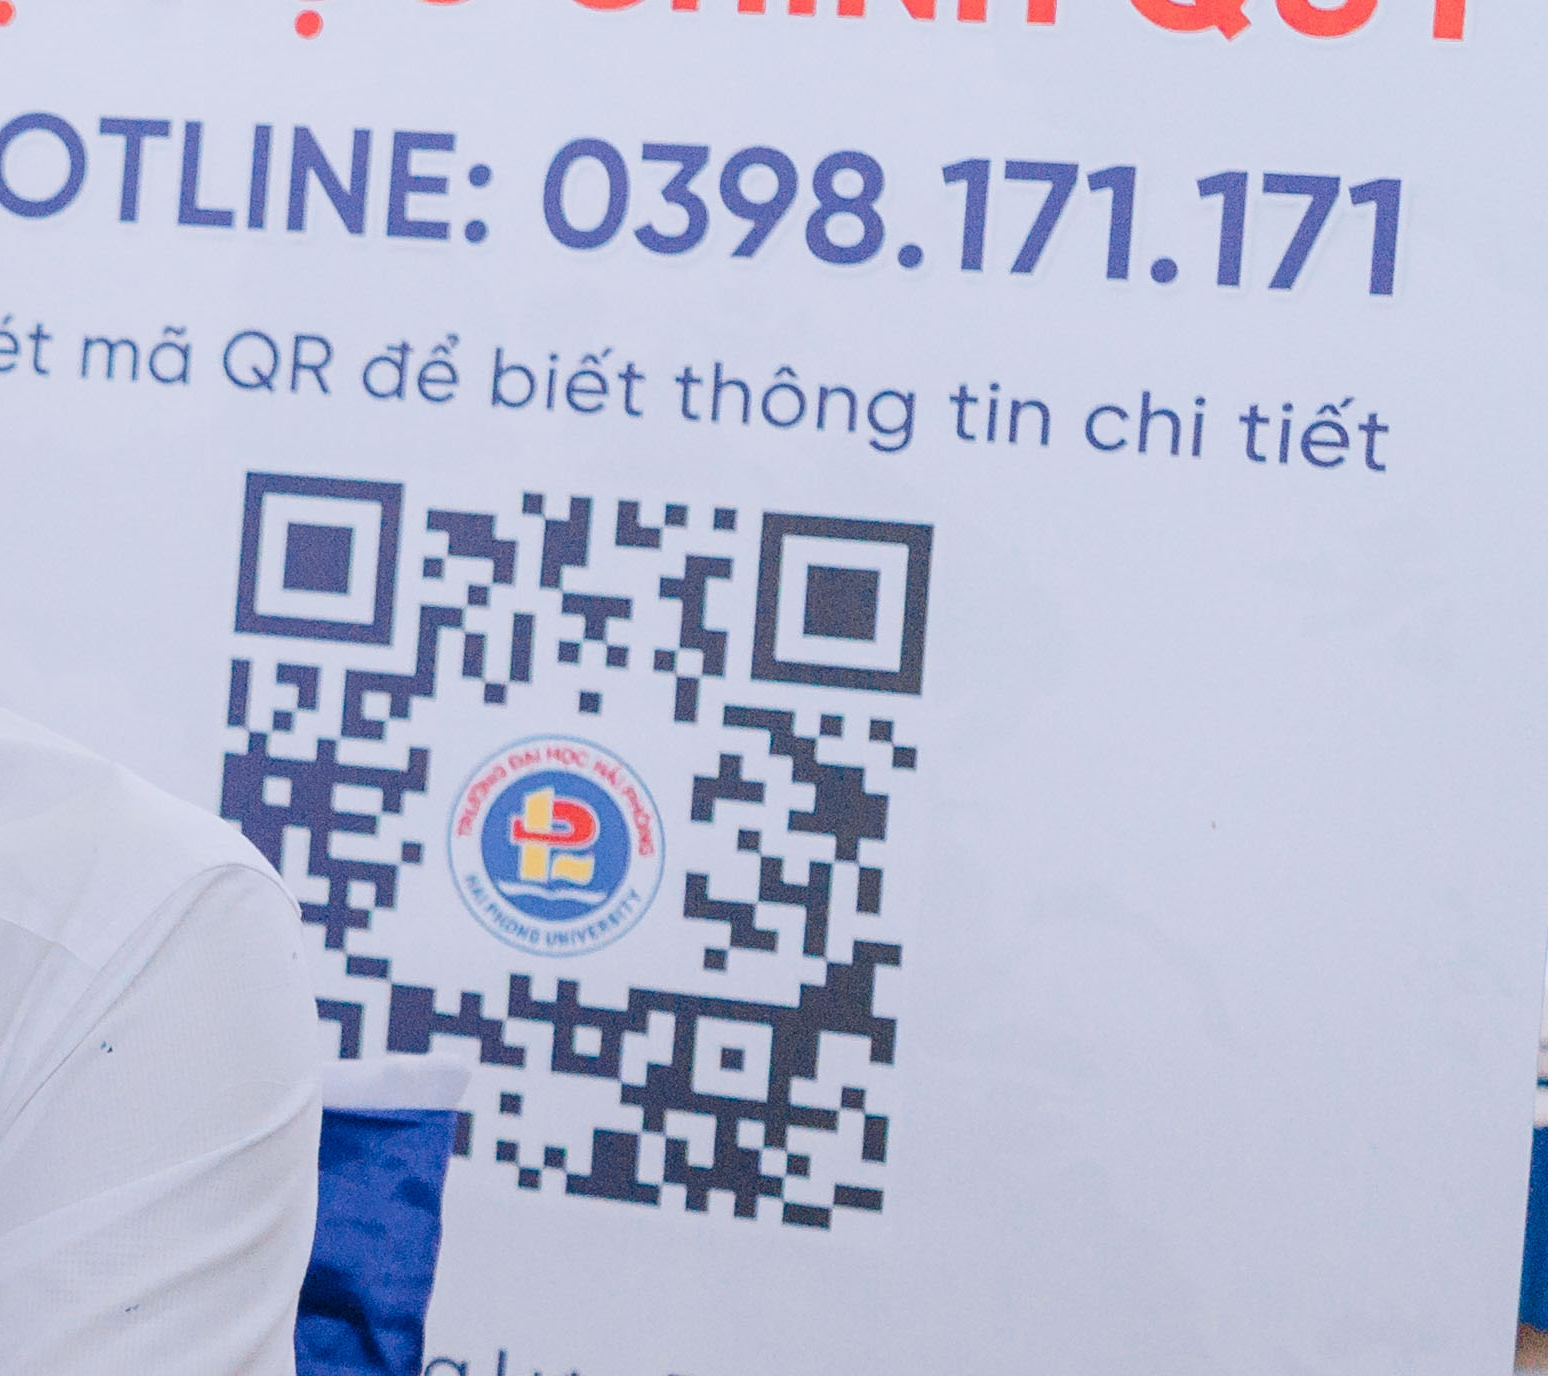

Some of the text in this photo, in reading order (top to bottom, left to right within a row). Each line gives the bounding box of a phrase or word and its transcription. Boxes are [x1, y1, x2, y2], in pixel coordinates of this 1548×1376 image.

[541, 137, 1404, 297] 0398.171.171
[79, 324, 193, 387] mã
[220, 327, 334, 395] QR
[361, 333, 461, 404] để
[489, 348, 646, 420] biết
[675, 361, 919, 451] thông
[947, 378, 1051, 446] tin
[1085, 393, 1204, 457] chi
[1240, 394, 1390, 473] tiết
